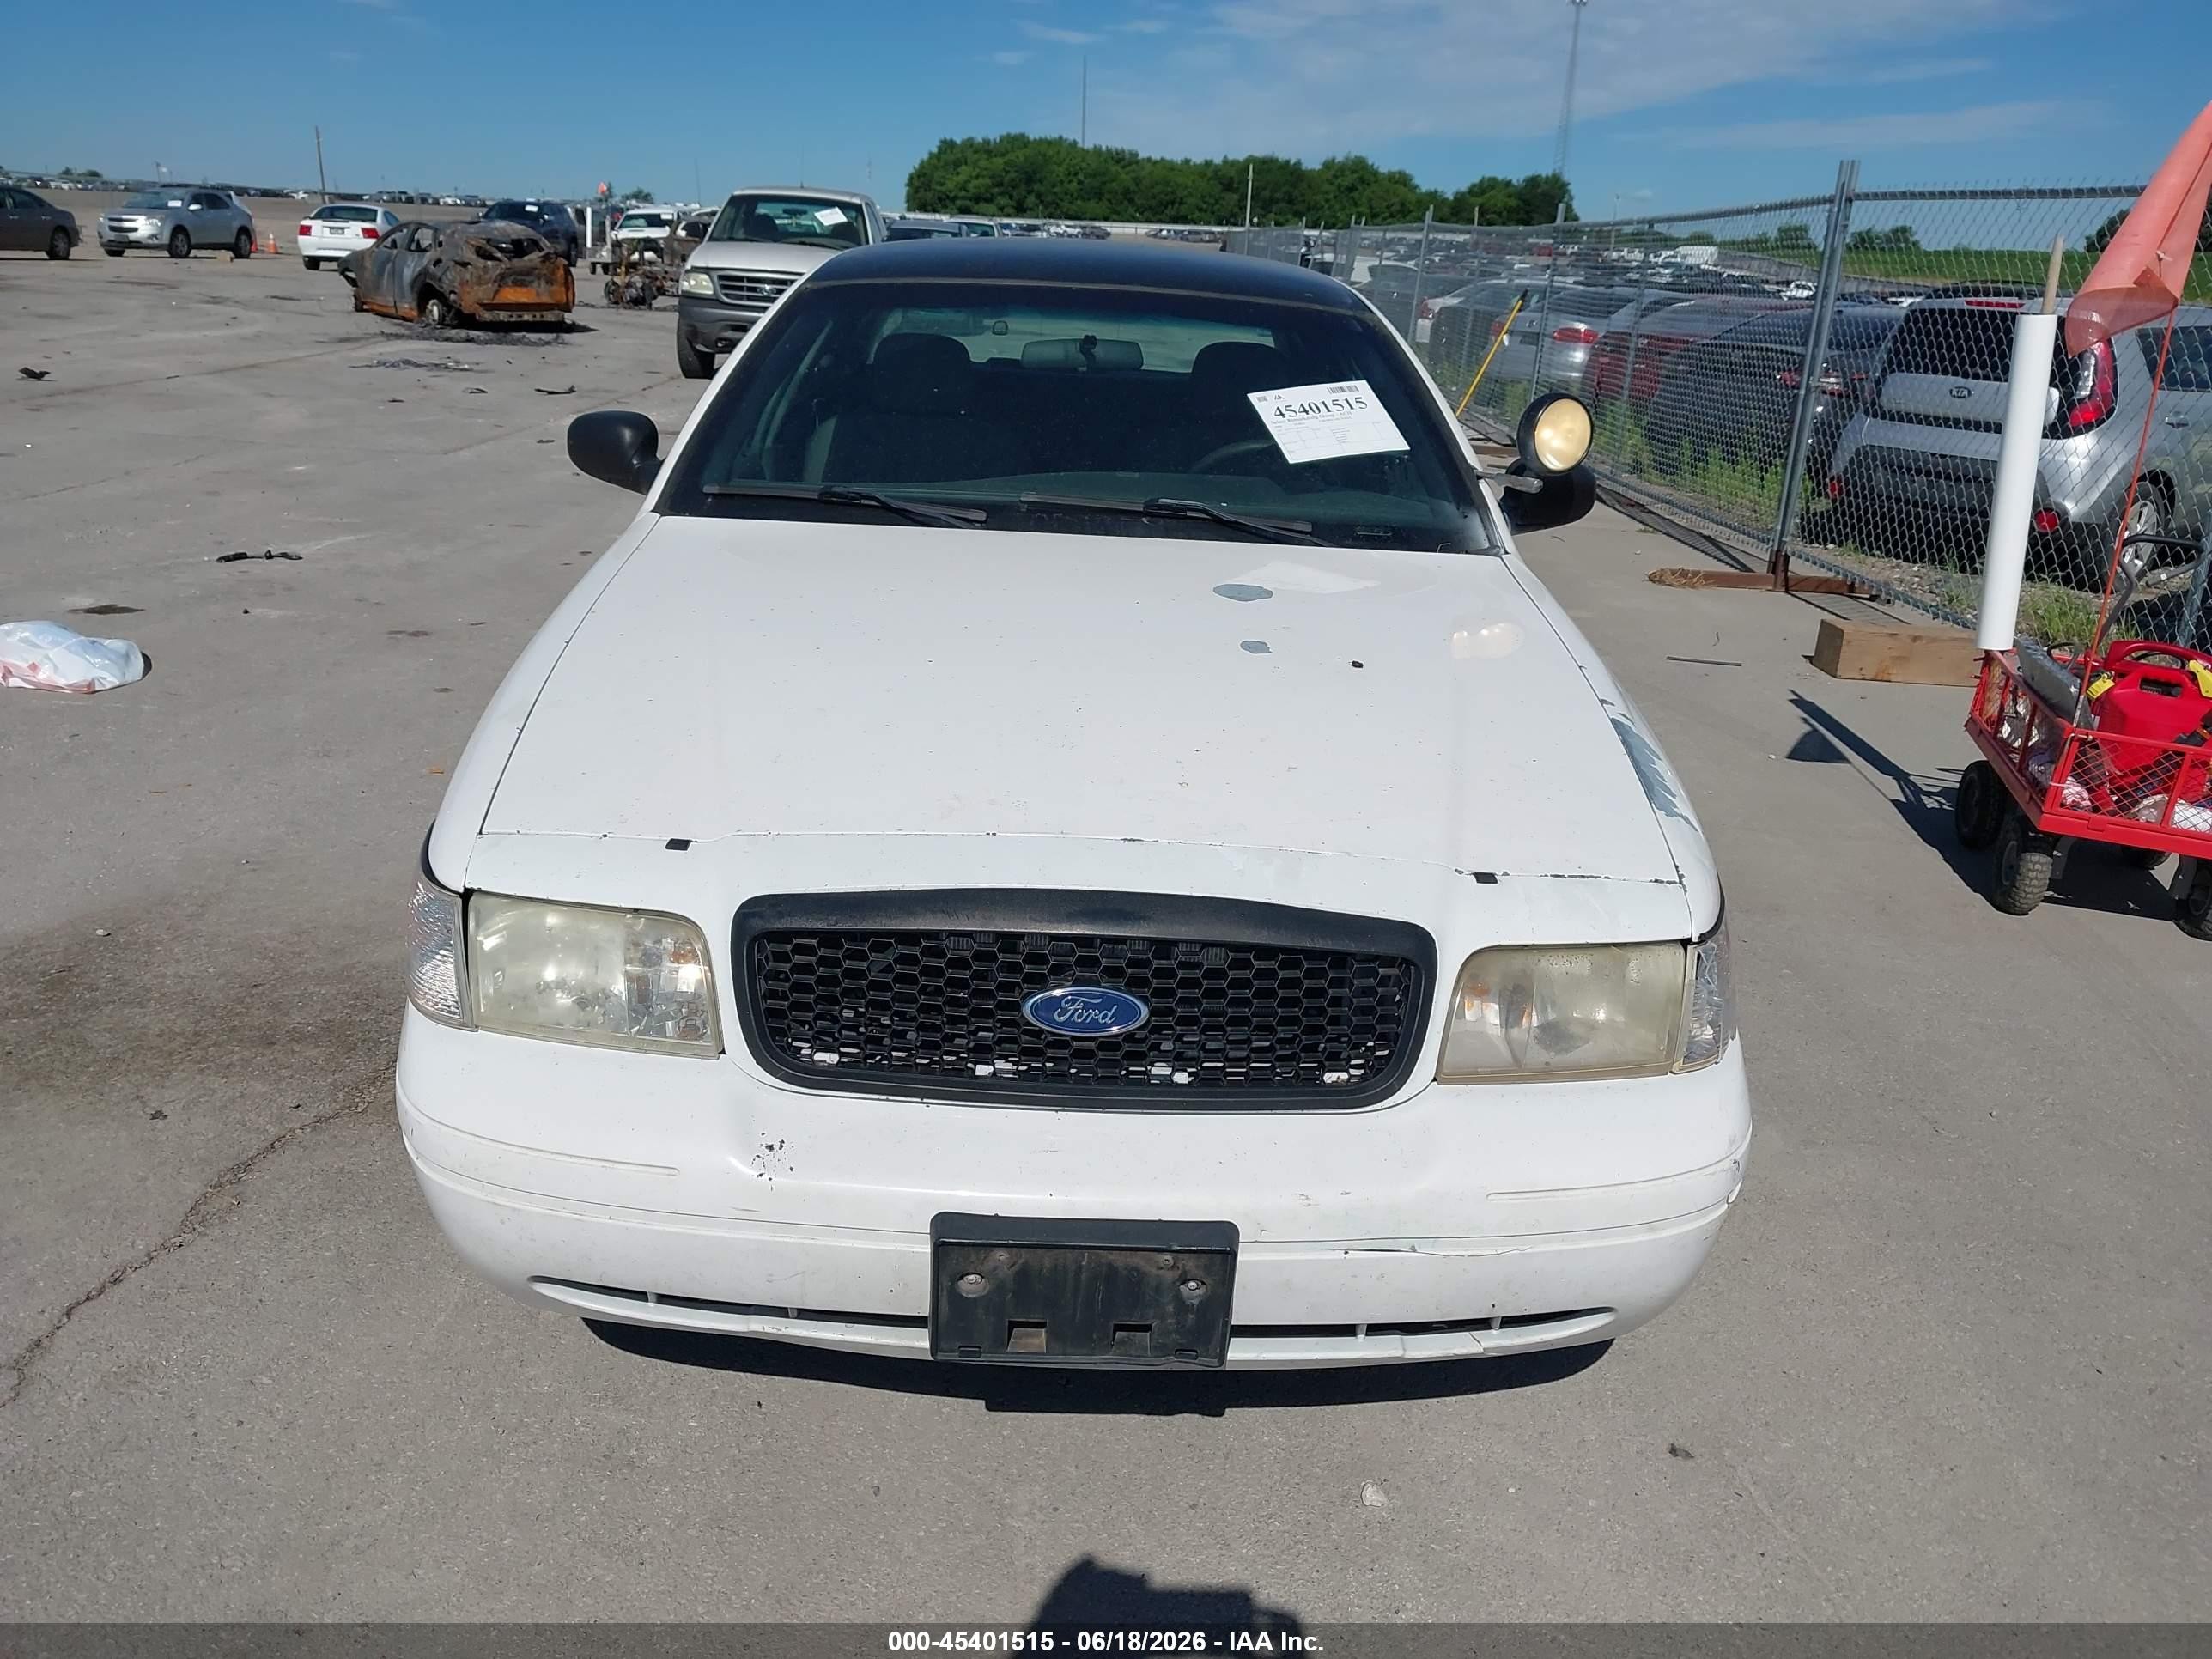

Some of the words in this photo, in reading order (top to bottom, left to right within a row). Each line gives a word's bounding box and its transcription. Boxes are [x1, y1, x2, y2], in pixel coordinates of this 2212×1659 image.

[1952, 388, 1969, 398] KIA
[1273, 397, 1368, 419] 45401515
[1054, 995, 1118, 1024] Ford
